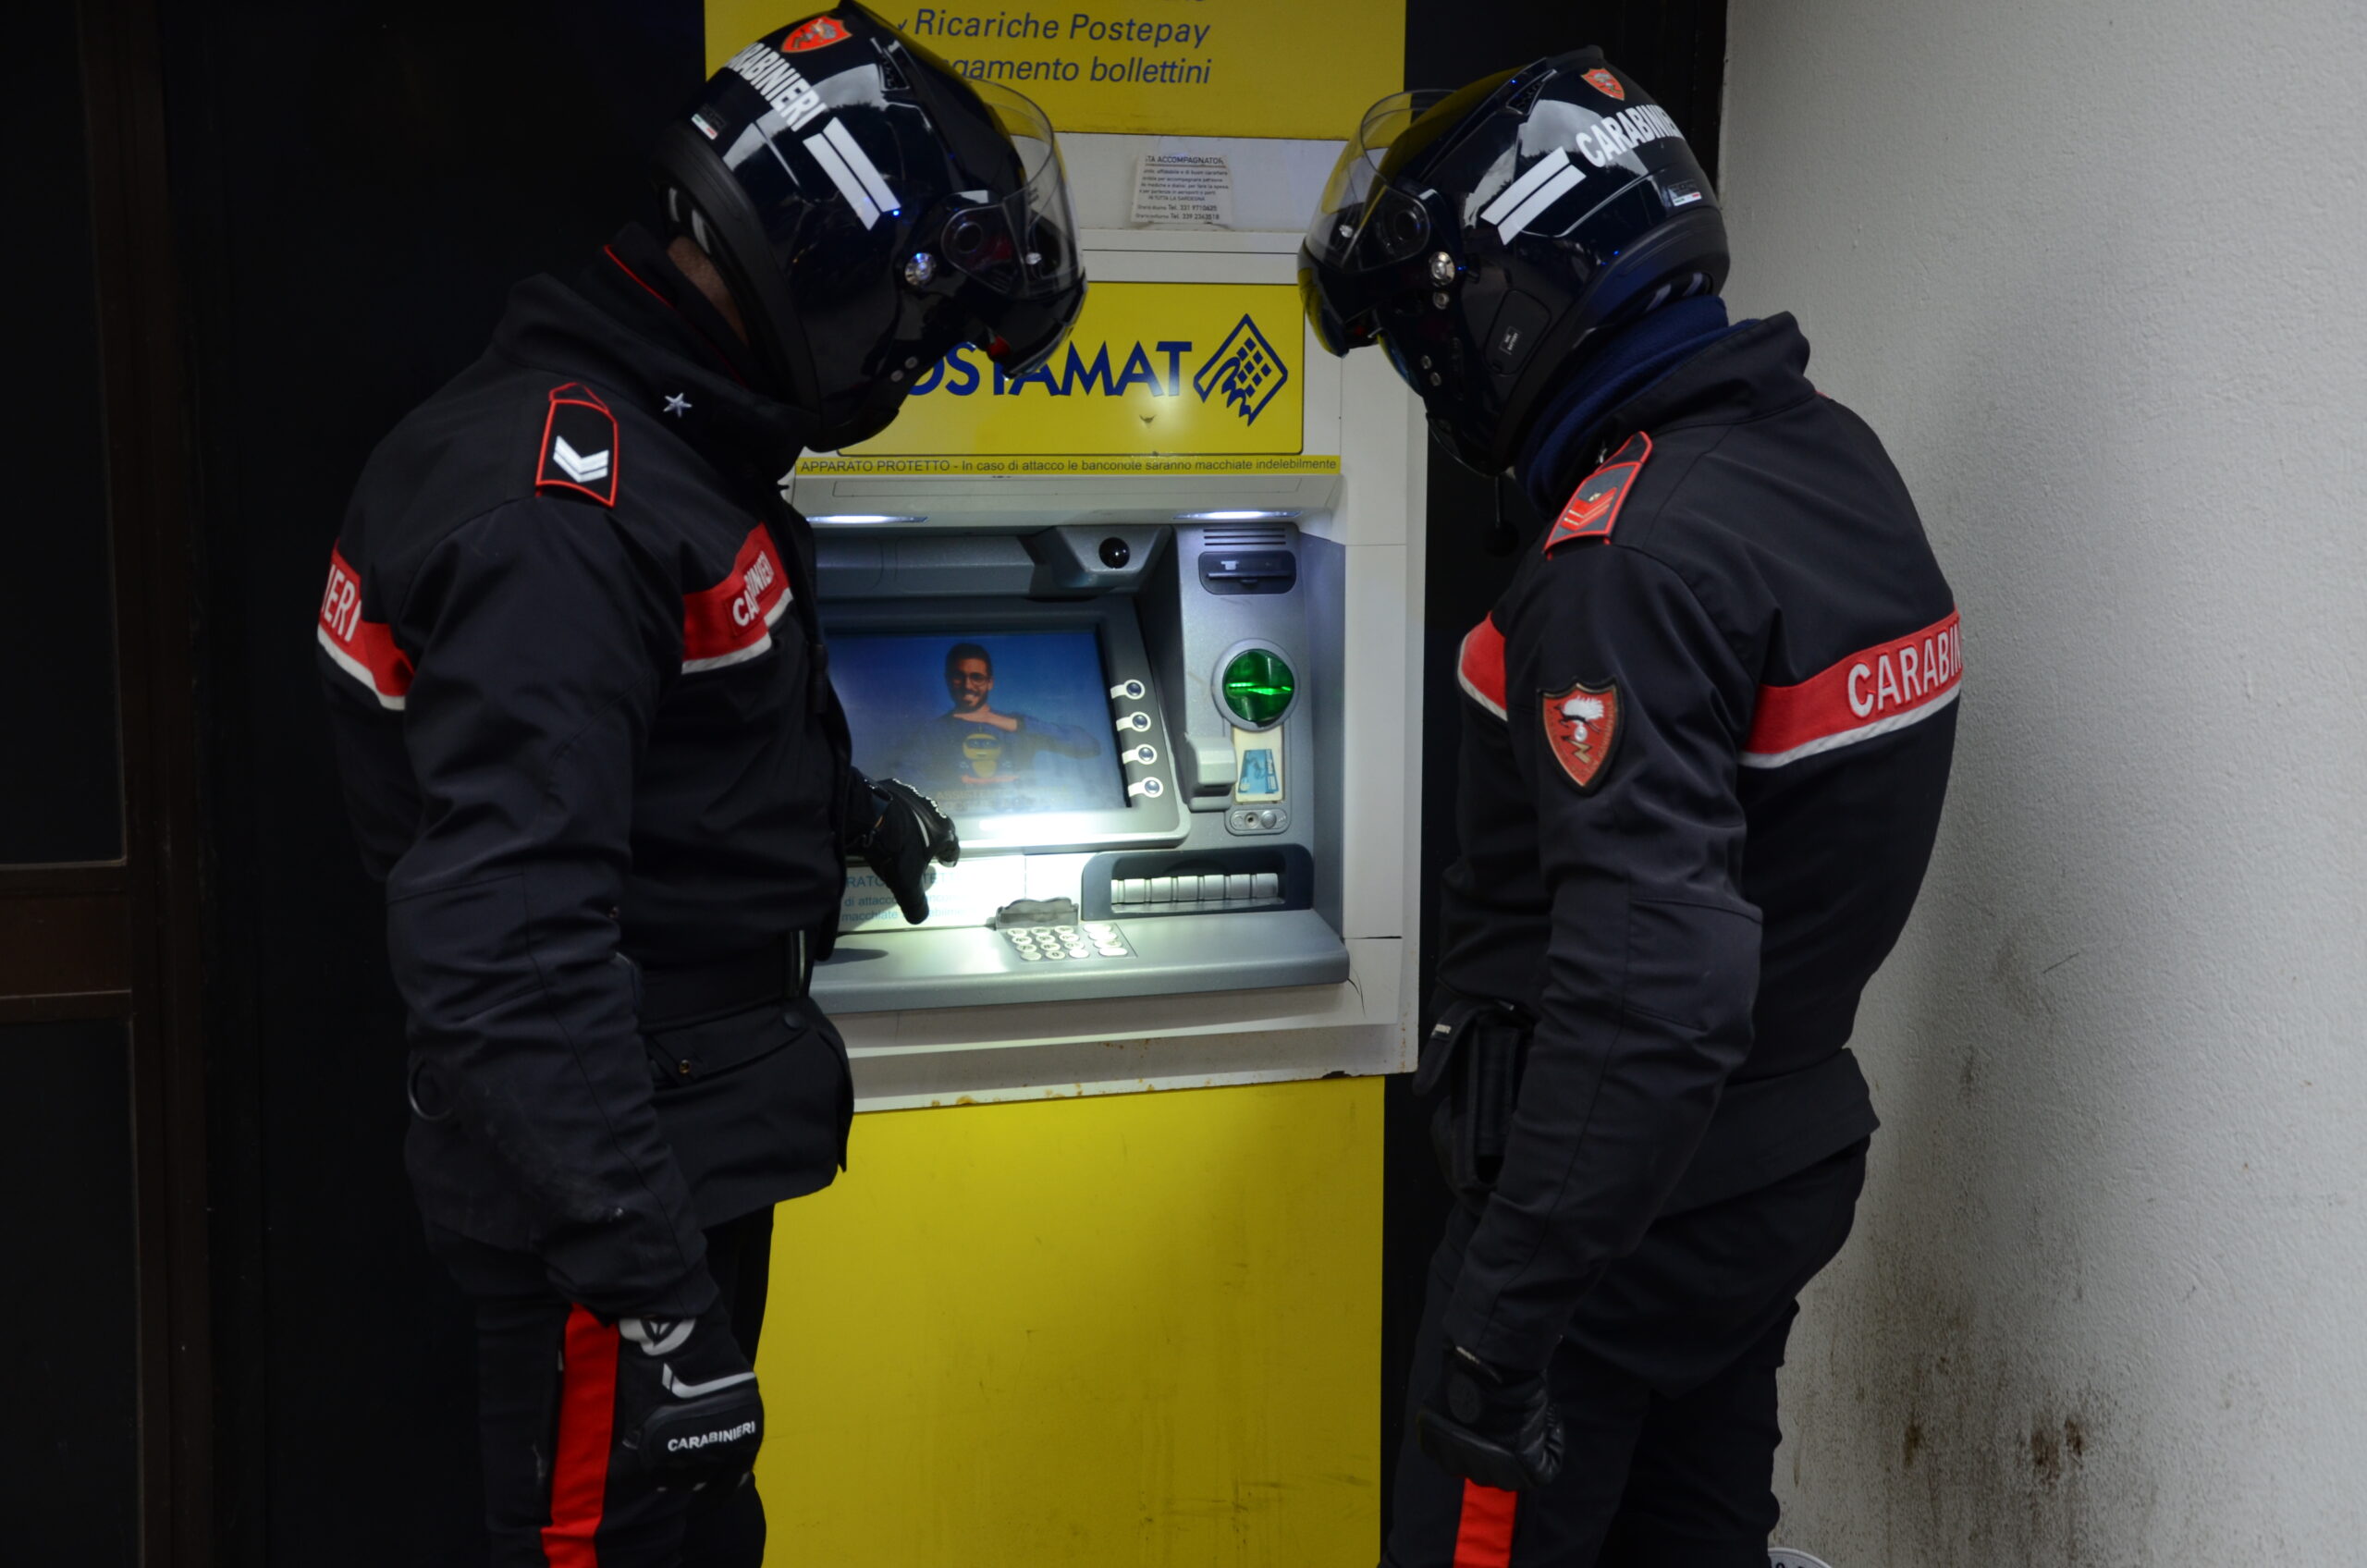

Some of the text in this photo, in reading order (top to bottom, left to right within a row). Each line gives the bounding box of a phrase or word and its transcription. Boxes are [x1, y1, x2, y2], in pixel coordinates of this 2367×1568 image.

[914, 8, 1210, 48] Ricariche Postepay
[942, 56, 1212, 84] gamento bollettini
[1576, 104, 1686, 167] CARABINIE
[908, 340, 1192, 397] SAMAT
[801, 459, 872, 472] APPARATO
[877, 459, 950, 472] PROTETTO
[962, 459, 972, 471] In
[976, 461, 1004, 472] caso
[1008, 459, 1019, 472] di
[1022, 459, 1065, 472] attacco
[1068, 459, 1078, 471] le
[1082, 459, 1142, 471] banconote
[1146, 460, 1191, 471] saranno
[1195, 459, 1252, 471] macchiate
[1256, 458, 1337, 470] indelebilmente
[1847, 623, 1962, 718] CARABIN
[668, 1421, 755, 1452] CARABINIERI
